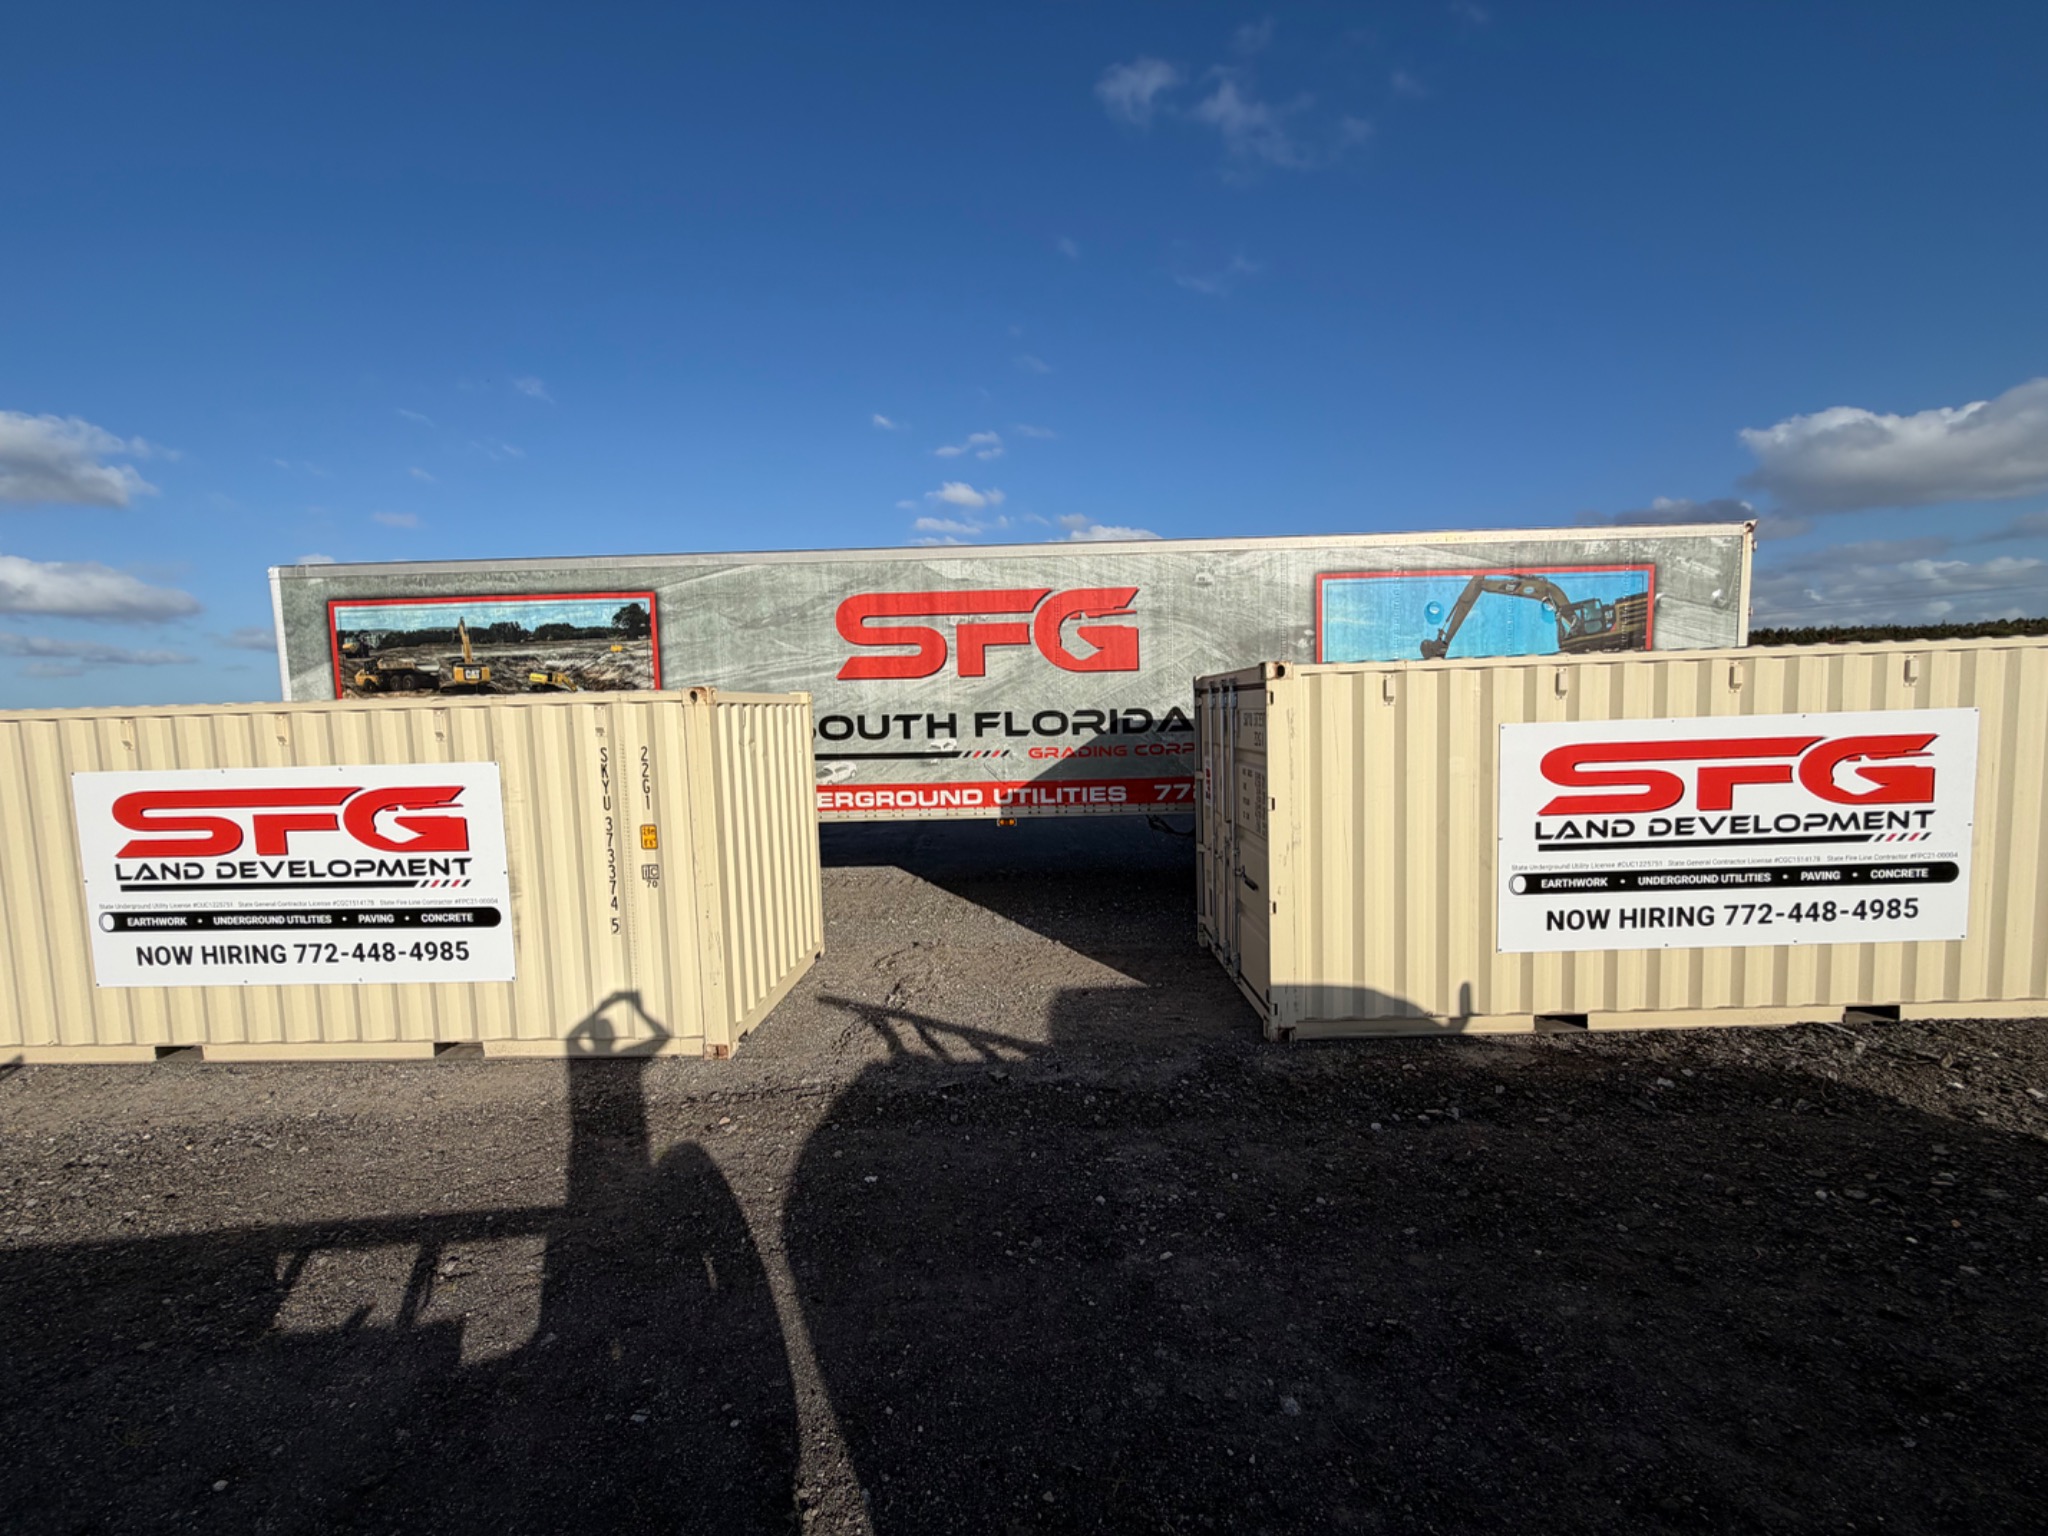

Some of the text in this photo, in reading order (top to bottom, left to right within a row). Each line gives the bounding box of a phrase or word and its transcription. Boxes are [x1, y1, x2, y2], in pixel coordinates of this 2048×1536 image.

[835, 587, 1140, 680] SFG
[812, 706, 1195, 741] OUTH FLORIDA
[1028, 742, 1195, 759] GRADING CORP
[600, 746, 612, 812] SKYU
[1537, 733, 1939, 816] SFG
[993, 786, 1127, 805] UTILITIES
[1154, 783, 1196, 800] 77
[112, 786, 470, 858] SFG
[1535, 810, 1936, 840] LAND DEVELOPMENT
[115, 858, 473, 881] LAND DEVELOPMENT
[1512, 863, 1528, 871] State
[1529, 862, 1570, 872] Underground
[1686, 858, 1711, 866] General
[1712, 857, 1746, 865] Contractor
[1748, 856, 1772, 864] License
[1827, 854, 1844, 862] State
[1541, 868, 1929, 888] EARTHWORK UNDERGROUND UTILITIES PAVING CONCRETE
[115, 903, 151, 911] Underground
[1546, 897, 1919, 931] NOW HIRING 772-448-4985
[127, 912, 474, 928] EARTHWORK UNDERGROUND UTILITIES PAVING CONCRETE
[136, 941, 470, 966] NOW HIRING 772-448-4985
